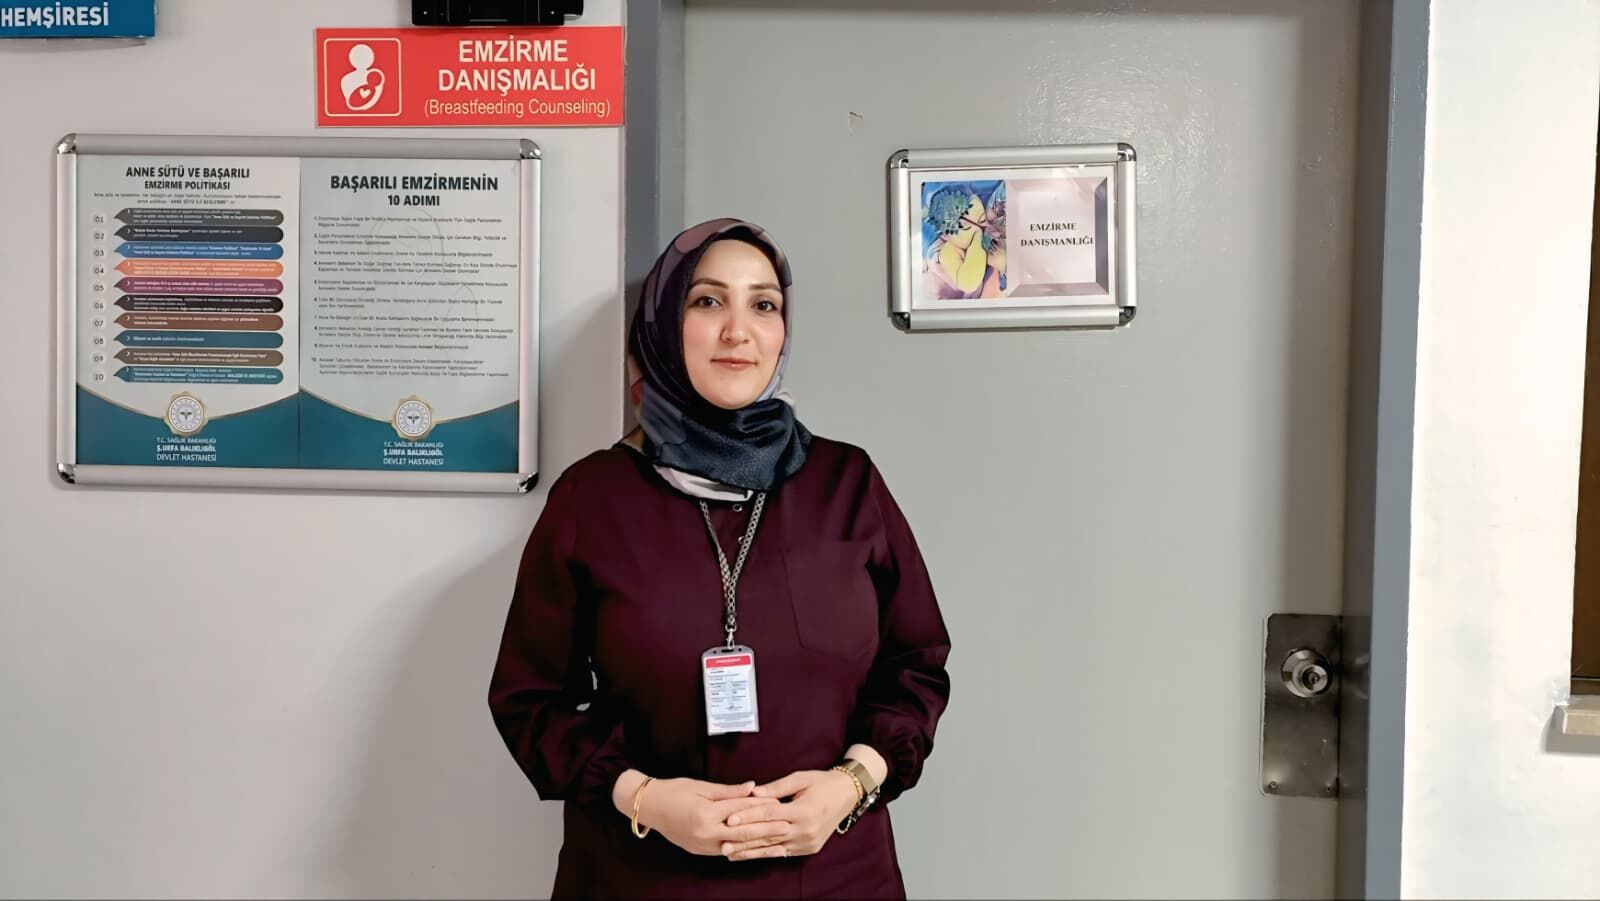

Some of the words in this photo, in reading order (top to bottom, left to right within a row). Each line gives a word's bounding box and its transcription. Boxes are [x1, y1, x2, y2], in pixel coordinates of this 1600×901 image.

[1, 1, 110, 29] HEMŞİRESİ
[458, 35, 568, 62] EMZİRME
[438, 63, 596, 96] DANIŞMALIĞI
[424, 98, 524, 118] (Breastfeeding
[528, 98, 610, 118] Counseling)
[125, 167, 155, 178] ANNE
[158, 164, 185, 178] SÜTÜ
[187, 167, 201, 178] VE
[203, 168, 250, 181] BAŞARILI
[144, 179, 183, 190] EMZİRME
[185, 180, 231, 190] POLİTİKASI
[330, 175, 397, 193] BAŞARILI
[402, 172, 499, 191] EMZİRMENİN
[388, 195, 400, 206] 10
[403, 195, 440, 206] ADIMI
[1030, 222, 1077, 231] EMZİRME
[1020, 235, 1094, 247] DANIŞMANLIĞI
[156, 453, 180, 461] DEVLET
[181, 453, 217, 462] HASTANESİ
